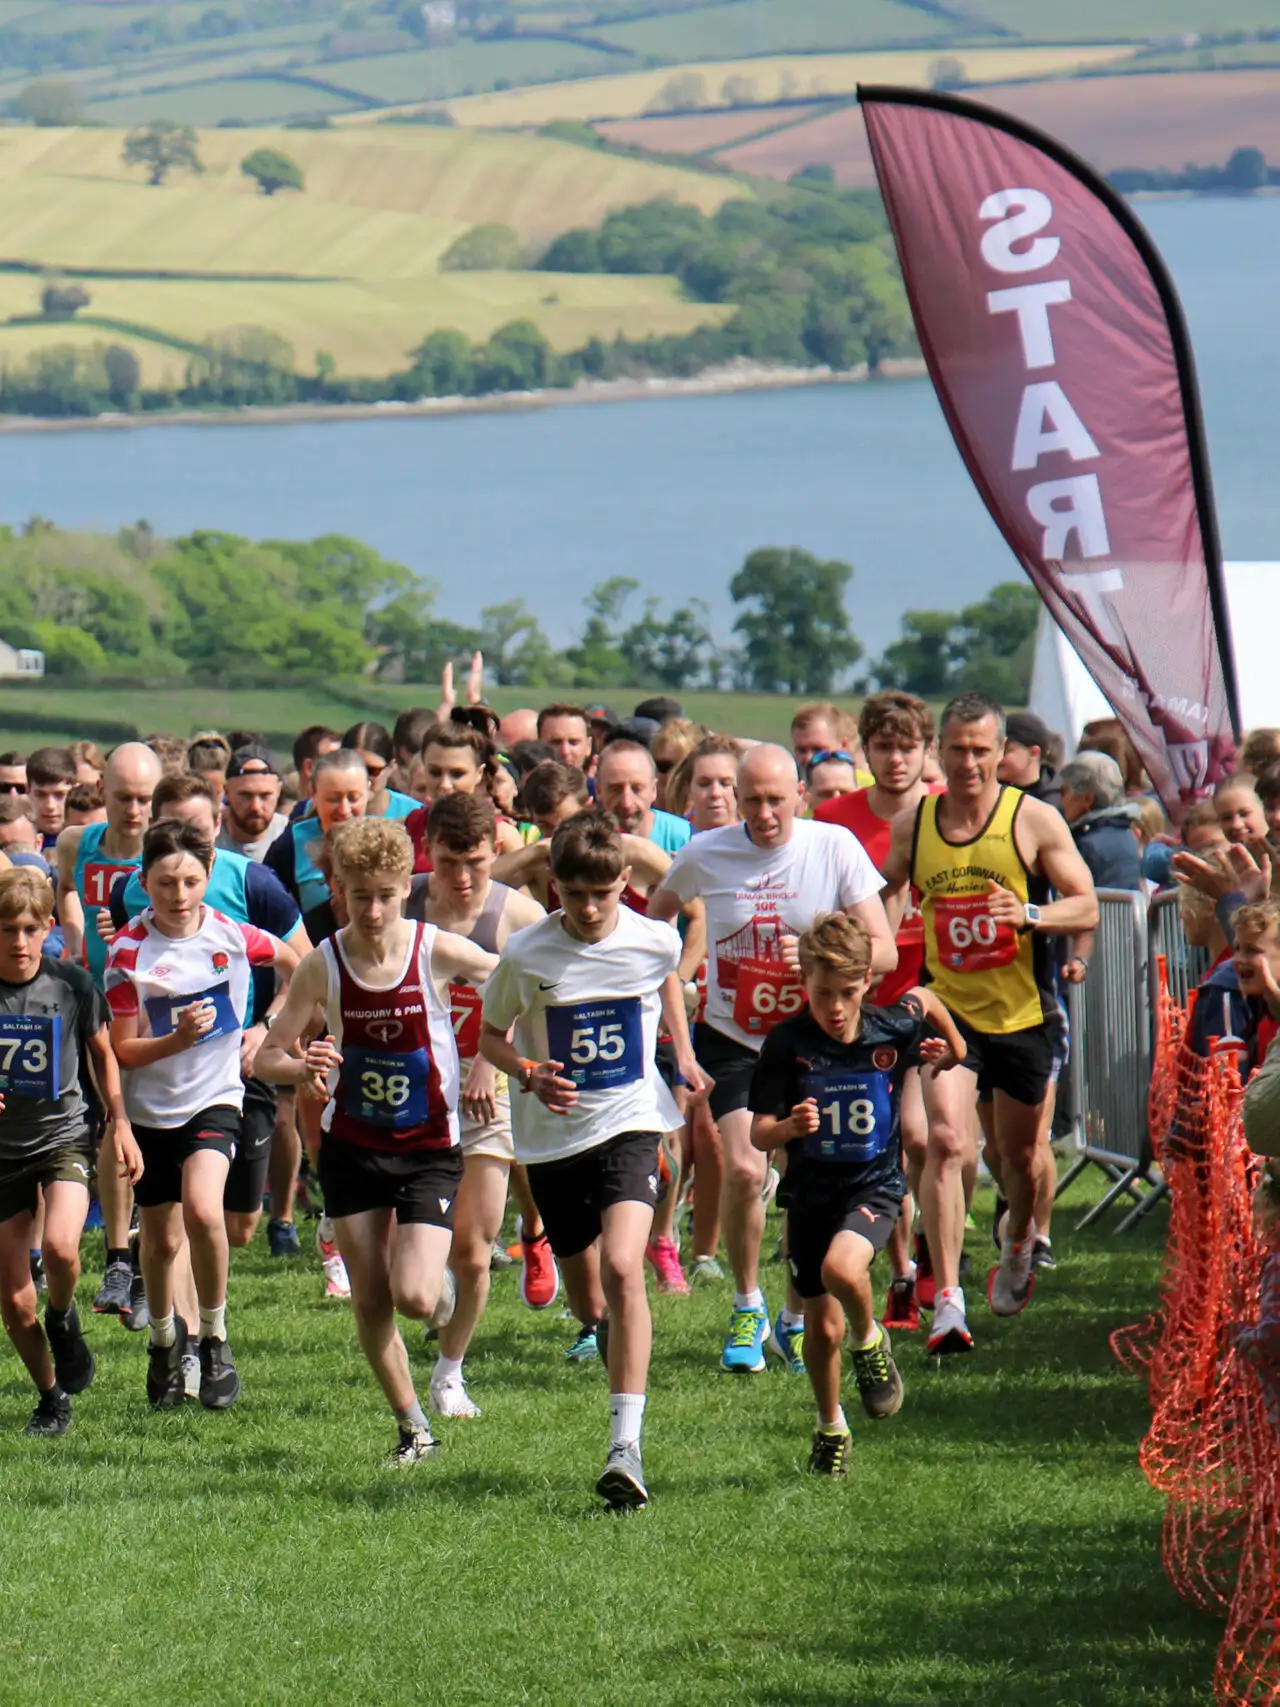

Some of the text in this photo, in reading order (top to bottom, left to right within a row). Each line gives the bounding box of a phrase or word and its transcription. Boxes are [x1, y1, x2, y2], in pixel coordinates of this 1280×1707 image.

[925, 865, 1007, 889] EAST CORNWALL
[754, 902, 777, 912] 10K
[948, 914, 997, 948] 60
[752, 982, 802, 1014] 65
[344, 1003, 423, 1019] NEWQUAY & PAR
[573, 1008, 616, 1020] SALTASH 5K
[2, 1023, 33, 1031] SALTASH
[570, 1023, 626, 1064] 55
[360, 1070, 411, 1107] 38
[824, 1082, 869, 1093] SALTASH 5K
[822, 1098, 876, 1135] 18
